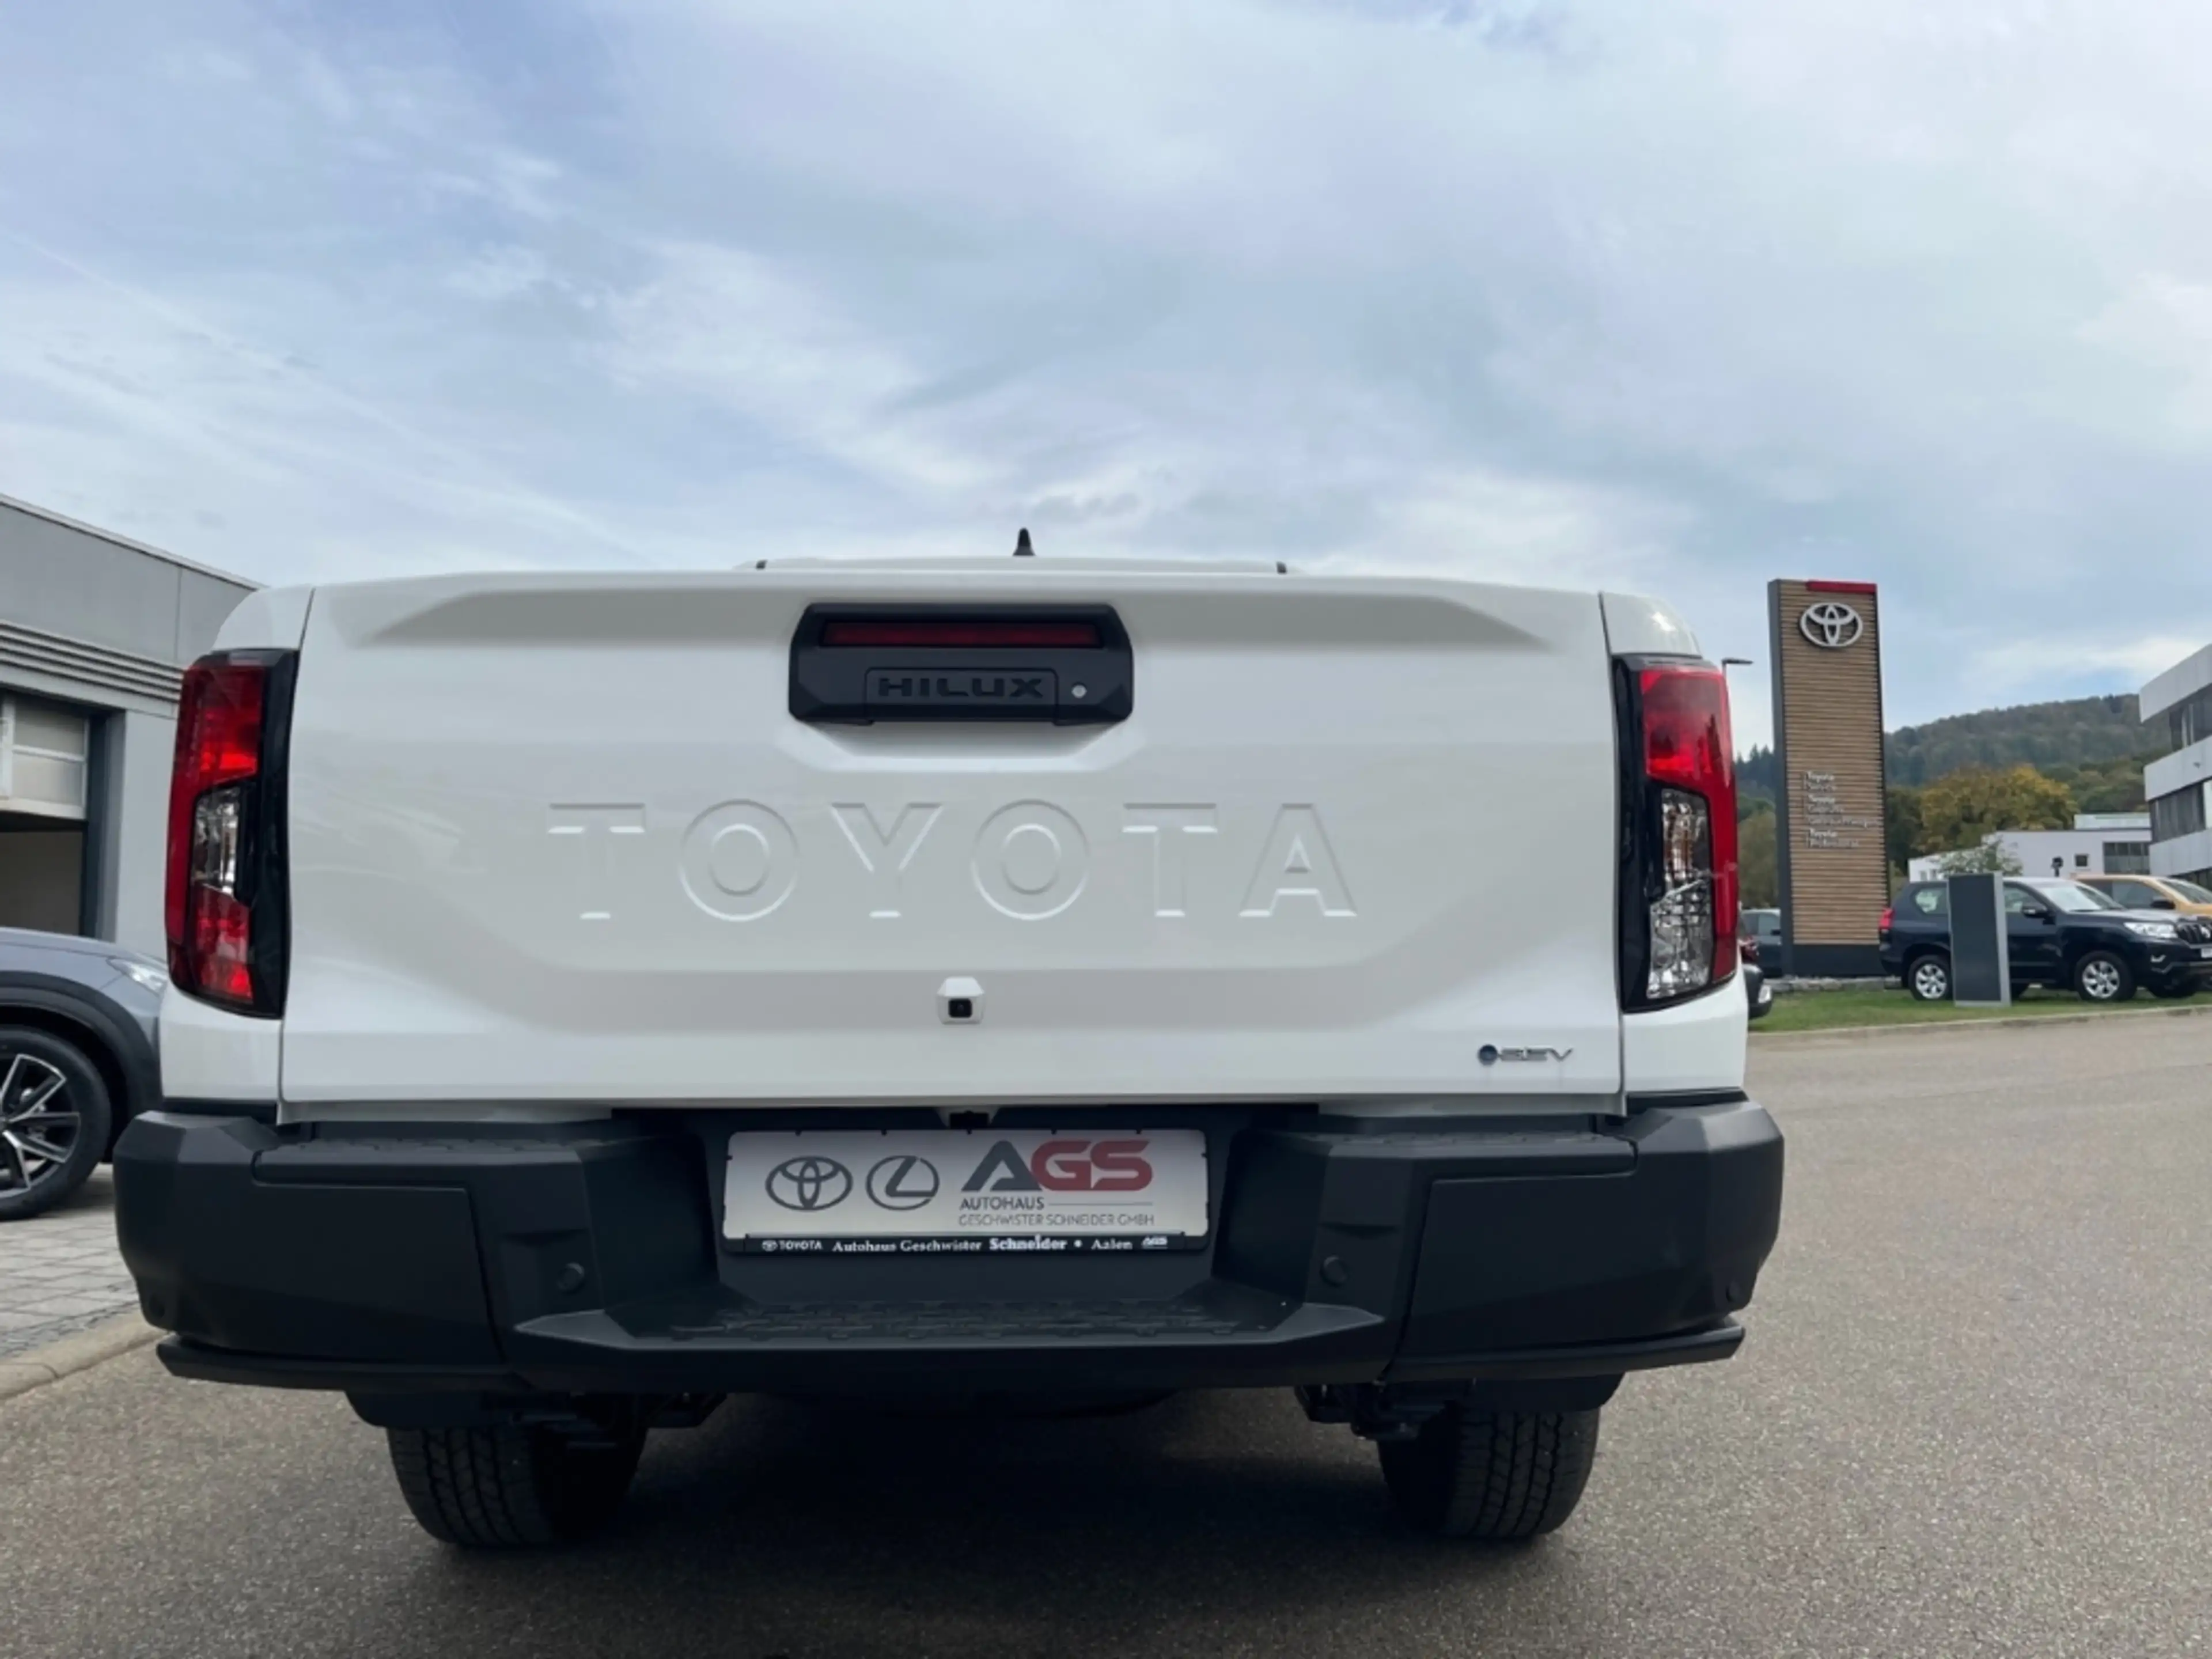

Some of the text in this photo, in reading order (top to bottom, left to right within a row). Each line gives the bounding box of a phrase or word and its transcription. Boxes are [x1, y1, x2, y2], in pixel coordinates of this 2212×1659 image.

[878, 677, 1044, 698] HILUX
[548, 798, 1357, 921] TOYOTA
[961, 1140, 1154, 1192] AGS
[959, 1196, 1044, 1210] AUTOHAUS
[959, 1213, 1043, 1226] GESCHWISTER
[1046, 1213, 1116, 1226] SCHNEIDER
[779, 1240, 823, 1251] TOYOTA
[832, 1240, 897, 1252] Autohaus
[900, 1240, 982, 1252] Geschwister
[989, 1236, 1067, 1250] Schneider
